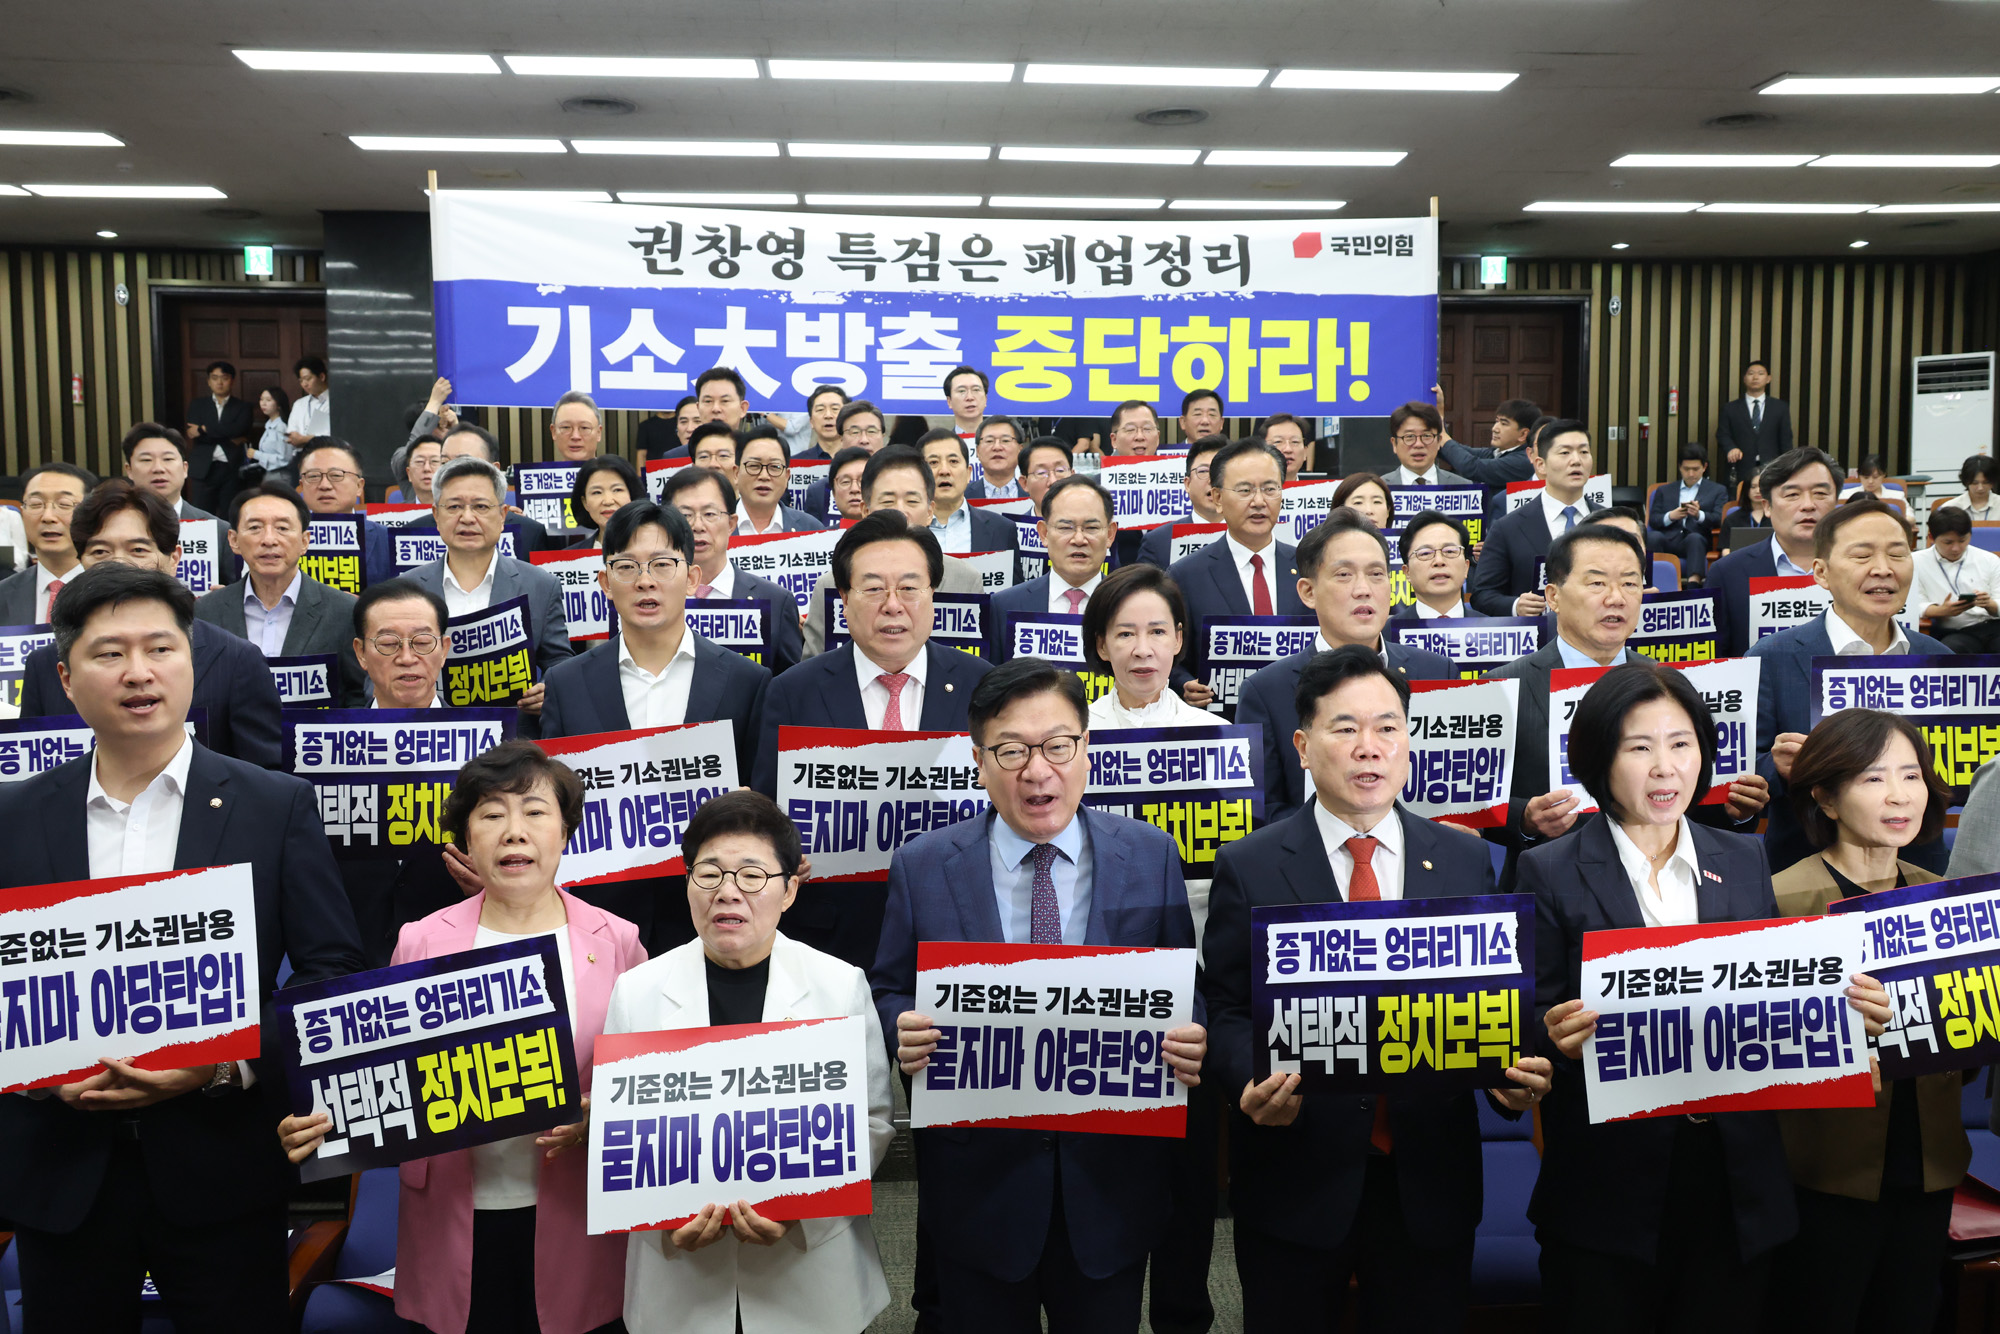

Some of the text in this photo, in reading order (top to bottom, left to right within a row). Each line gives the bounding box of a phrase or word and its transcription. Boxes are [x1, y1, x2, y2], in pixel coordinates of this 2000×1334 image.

[627, 220, 1251, 288] 권창영 특검은 폐업정리
[1329, 233, 1415, 258] 국민의힘
[503, 304, 1371, 403] 기소大방출 중단하라!
[523, 471, 564, 491] 증거없는
[1108, 473, 1147, 485] 기준없는
[1393, 492, 1480, 512] 증거없는 엉터리기소
[399, 540, 447, 562] 증거없는
[1642, 602, 1712, 633] 엉터리기소
[1761, 599, 1823, 619] 기준없는
[450, 613, 523, 654] 엉터리기소
[1019, 627, 1079, 657] 증거없는
[1213, 630, 1272, 656] 증거없는
[1464, 630, 1535, 659] 엉터리기소
[271, 669, 325, 697] 리기소
[448, 647, 533, 706] 정치보복!
[1828, 674, 1905, 710] 증거없는
[302, 729, 388, 767] 증거없는
[1409, 713, 1503, 740] 기소권남용
[619, 753, 722, 786] 기소권남용
[793, 762, 879, 791] 기준없는
[1146, 745, 1247, 785] 엉터리기소
[1402, 746, 1506, 804] 야당탄압!
[315, 781, 455, 847] 택적 정치
[788, 798, 869, 855] 묻지마
[95, 908, 236, 953] 기소권남용
[1274, 921, 1513, 975] 증거없는 엉터리기소
[1862, 911, 1928, 964] 거없는
[1599, 955, 1844, 1000] 기준없는 기소권남용
[0, 951, 246, 1053] 지마 야당탄압!
[302, 964, 545, 1055] 증거없는 엉터리기소
[934, 983, 1174, 1020] 기준없는 기소권남용
[1932, 964, 2000, 1050] 정치
[1267, 988, 1521, 1075] 선택적 정치보복!
[1594, 995, 1855, 1083] 묻지마 야당탄압!
[610, 1059, 848, 1106] 기준없는 기소권남용
[926, 1024, 1176, 1099] 묻지마 야당탄압!
[310, 1026, 567, 1160] 선택적 정치보복!
[601, 1102, 857, 1193] 묻지마 야당탄압!
